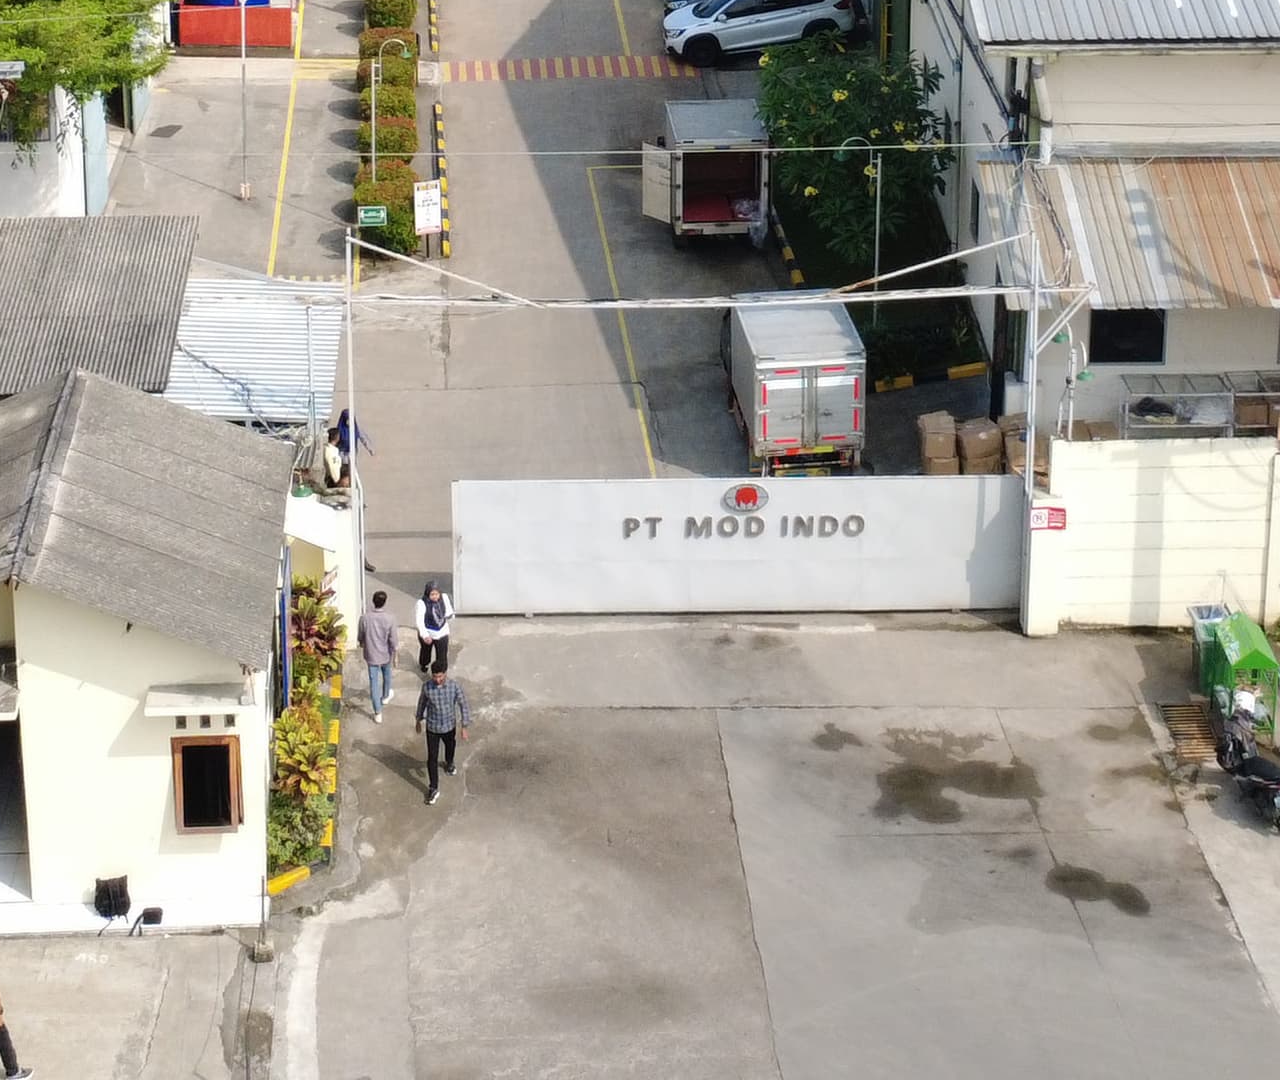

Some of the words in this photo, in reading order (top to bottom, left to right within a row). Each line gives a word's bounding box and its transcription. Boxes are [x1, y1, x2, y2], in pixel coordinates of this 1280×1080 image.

[623, 517, 662, 539] PT
[684, 515, 765, 539] MOD
[780, 514, 865, 538] INDO
